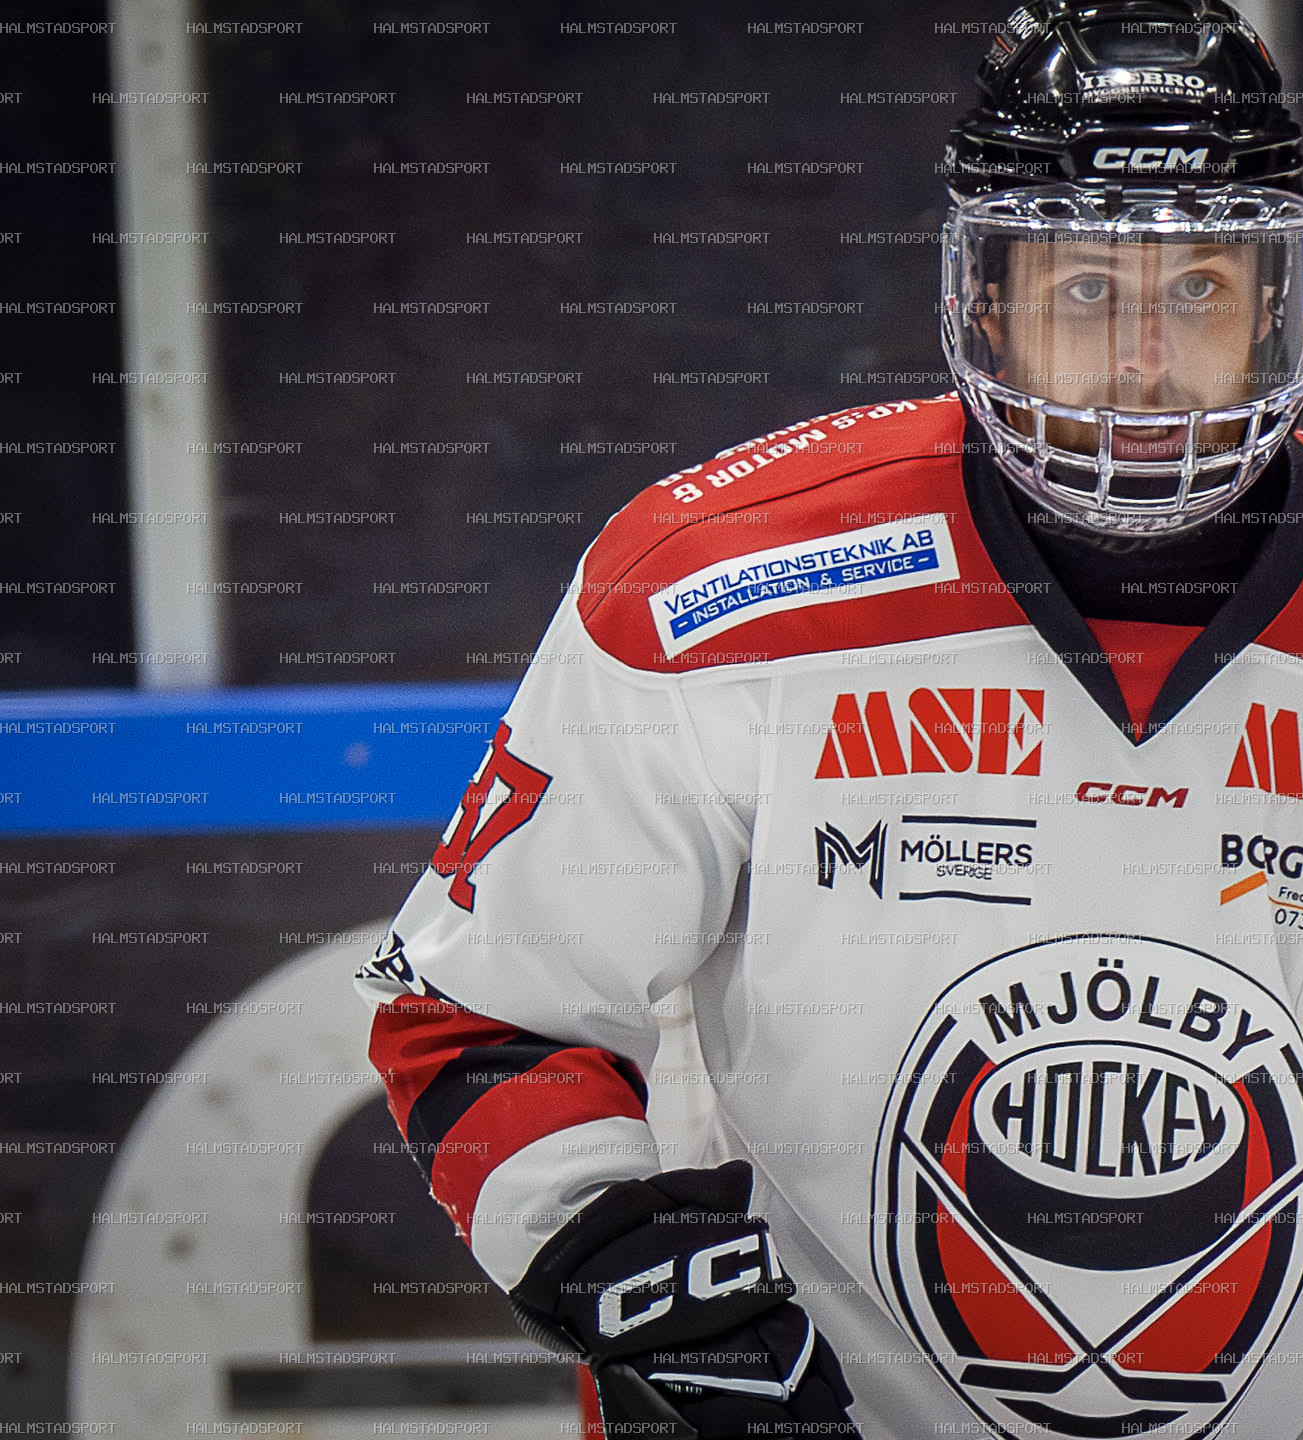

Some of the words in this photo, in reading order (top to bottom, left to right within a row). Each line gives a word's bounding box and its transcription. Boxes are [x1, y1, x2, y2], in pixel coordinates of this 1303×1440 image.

[1092, 147, 1209, 170] CCM
[705, 428, 828, 490] MOTOR
[664, 536, 897, 615] VENTILATIONSTEKNIK
[902, 529, 935, 552] AB
[691, 578, 810, 625] INSTALLATION
[820, 572, 834, 588] &
[842, 556, 915, 583] SERVICE
[814, 687, 1045, 779] MSE
[1075, 781, 1190, 809] CCM
[900, 834, 1033, 865] MÖLLERS
[936, 863, 993, 881] SVERIGE
[978, 958, 1274, 1061] MJÖLBY
[992, 1060, 1227, 1178] HOCKEY
[599, 1233, 783, 1338] CC
